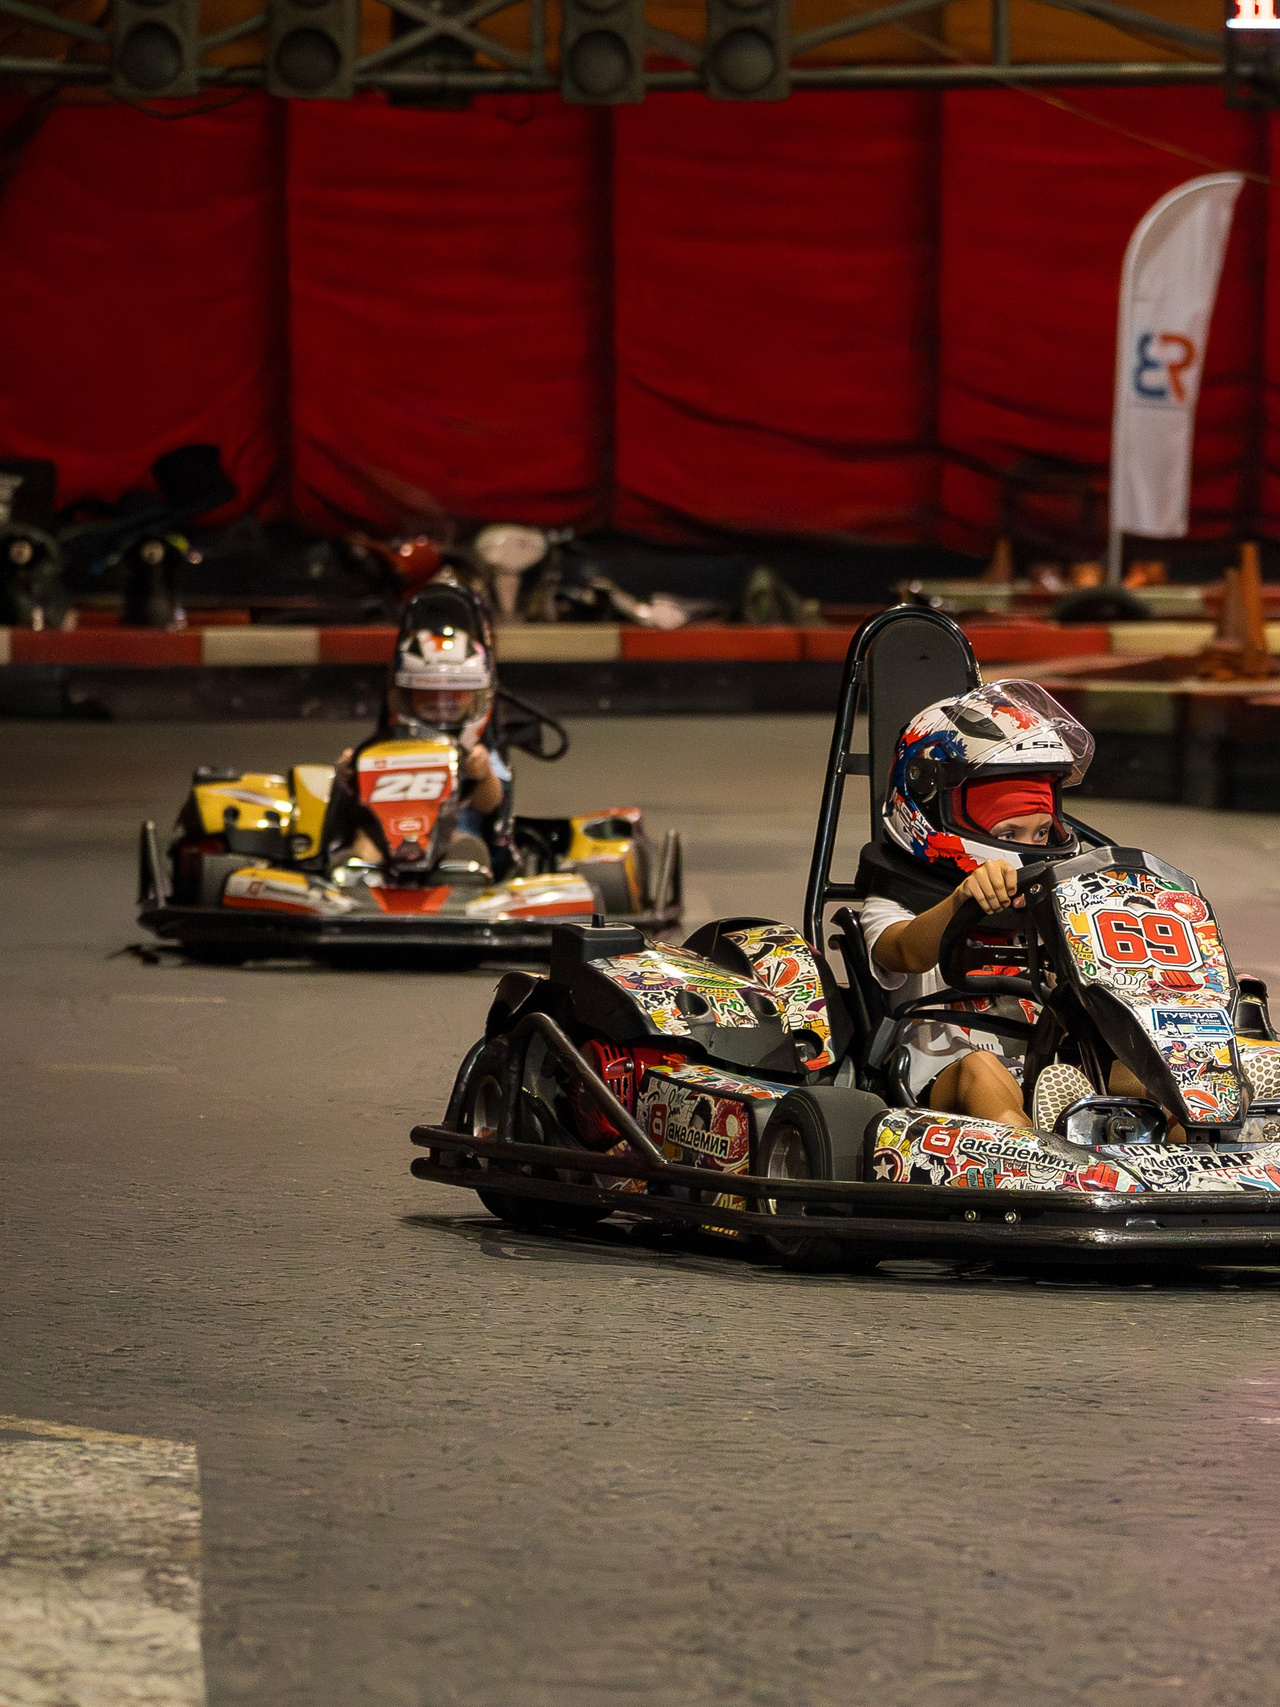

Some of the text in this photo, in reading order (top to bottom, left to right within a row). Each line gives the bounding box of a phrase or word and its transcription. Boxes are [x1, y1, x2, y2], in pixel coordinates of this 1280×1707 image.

[1015, 740, 1064, 752] LS2
[369, 771, 448, 803] 26
[1095, 909, 1196, 970] 69
[668, 1122, 729, 1157] академия
[961, 1138, 1075, 1171] академия
[1143, 1153, 1198, 1169] Matter
